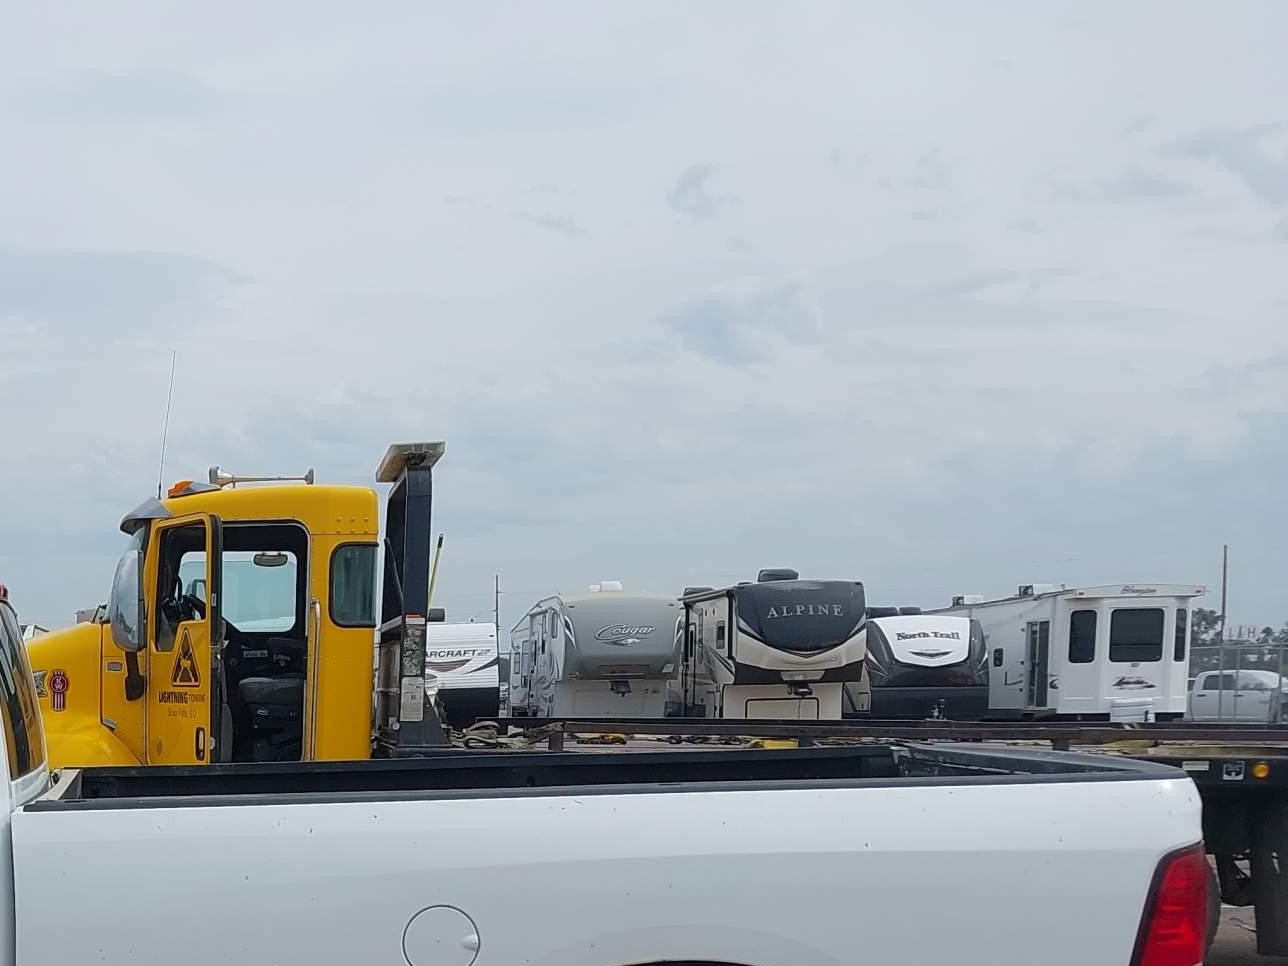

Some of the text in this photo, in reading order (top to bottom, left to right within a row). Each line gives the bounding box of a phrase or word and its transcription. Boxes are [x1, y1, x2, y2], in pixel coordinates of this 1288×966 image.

[767, 604, 844, 619] ALPINE
[594, 624, 656, 641] Cougar
[896, 631, 961, 641] North Trail
[158, 690, 188, 704] LIGHTNING
